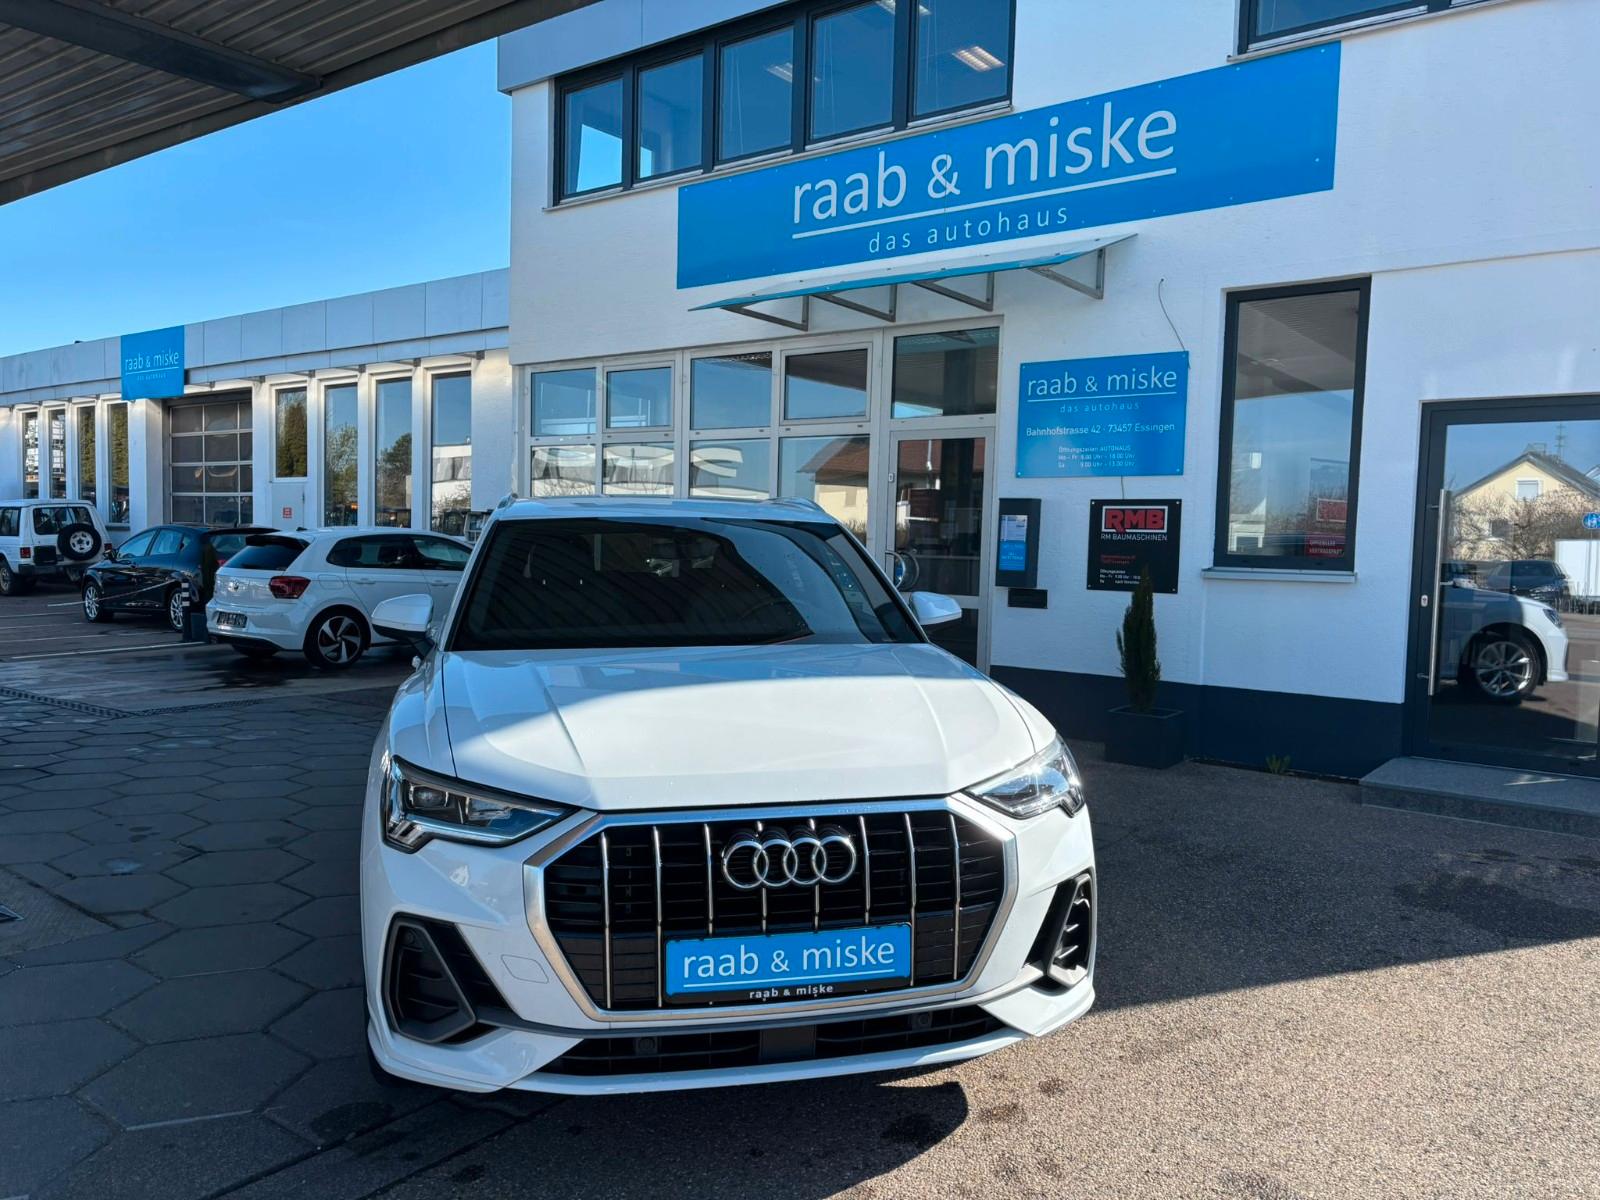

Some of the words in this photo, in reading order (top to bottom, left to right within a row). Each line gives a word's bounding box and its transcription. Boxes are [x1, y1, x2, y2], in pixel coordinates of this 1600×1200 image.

[794, 151, 908, 225] raab
[926, 153, 961, 200] &
[984, 102, 1177, 190] miske
[868, 231, 912, 254] das
[927, 205, 1070, 245] autohaus
[125, 353, 144, 371] raab
[146, 356, 151, 368] &
[153, 347, 179, 367] miske
[1028, 371, 1077, 396] raab
[1085, 376, 1098, 392] &
[1107, 365, 1177, 391] miske
[1060, 404, 1079, 413] das
[1084, 402, 1140, 412] autohaus
[1026, 426, 1089, 437] Bahnhofstrasse
[1091, 424, 1101, 434] 42
[1108, 423, 1132, 433] 73457
[1134, 423, 1175, 434] Essingen
[1106, 508, 1164, 533] RMB
[1112, 532, 1168, 541] BAUMASCHINEN
[684, 944, 759, 979] raab
[771, 950, 790, 973] &
[803, 935, 895, 970] miske
[749, 988, 779, 999] raab
[783, 988, 791, 996] &
[796, 984, 834, 996] miske
